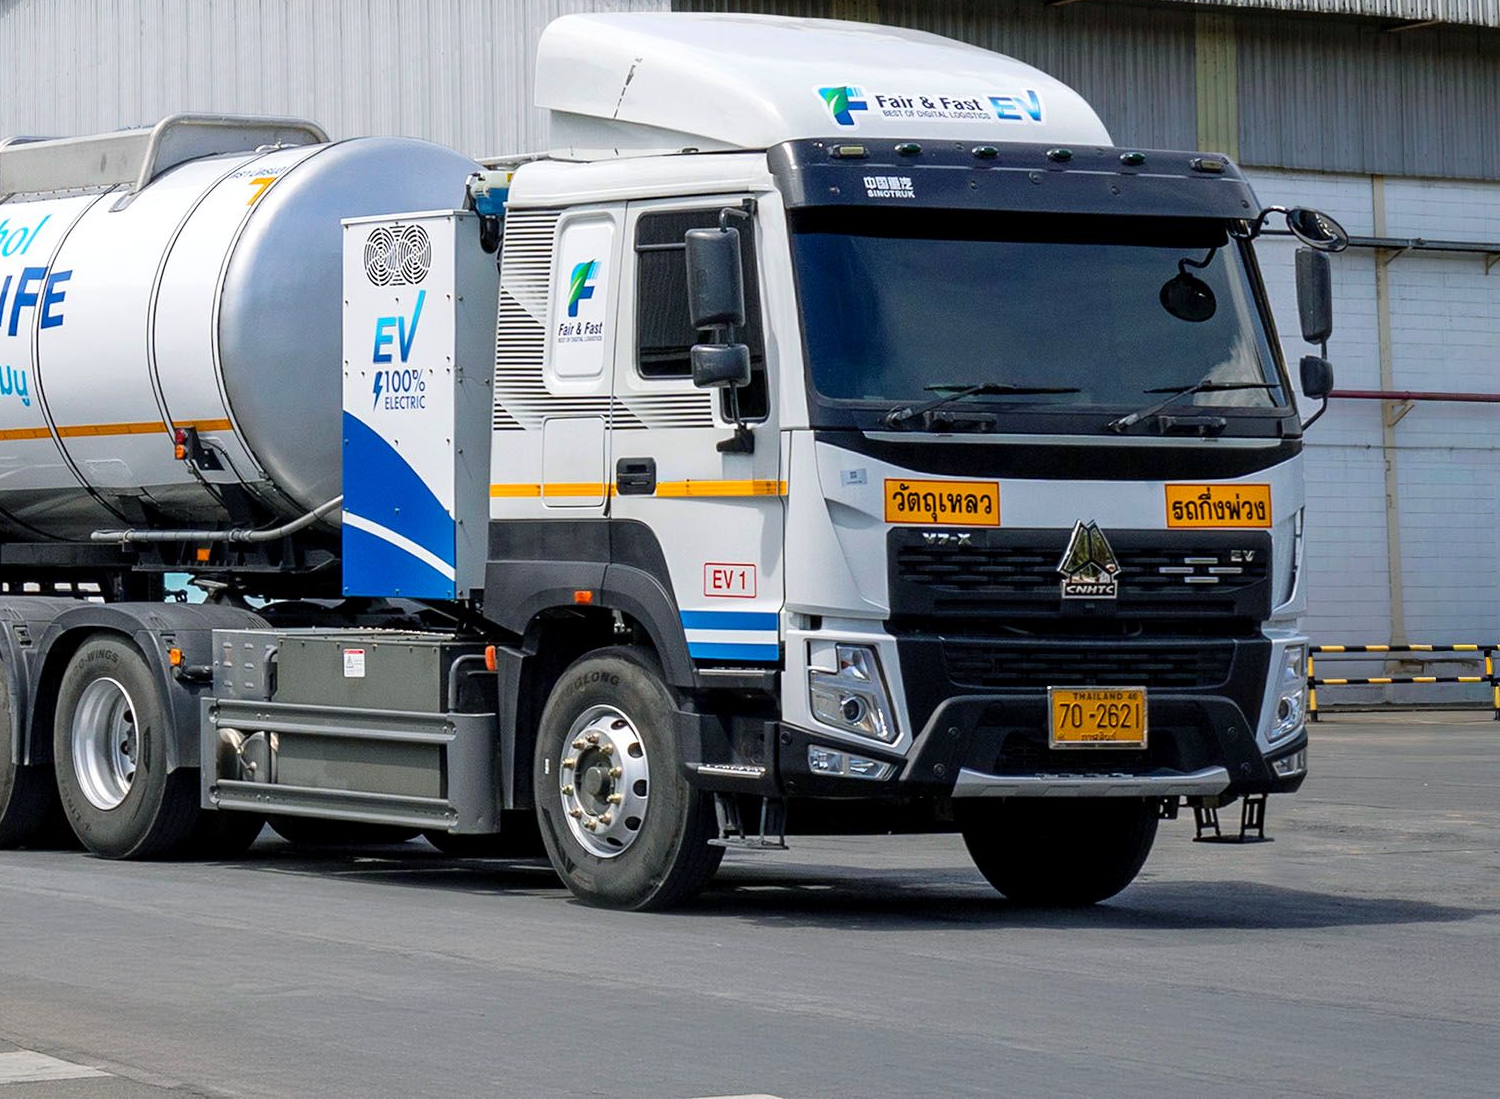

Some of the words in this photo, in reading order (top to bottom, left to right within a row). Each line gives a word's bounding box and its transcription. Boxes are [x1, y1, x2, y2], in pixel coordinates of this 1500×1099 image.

[875, 95, 914, 108] Fair
[919, 96, 936, 109] &
[939, 97, 983, 111] Fast
[988, 89, 1042, 122] EV
[867, 190, 915, 199] SINOTRUK
[373, 290, 426, 364] EV
[558, 322, 574, 336] Fair
[576, 322, 582, 335] &
[584, 321, 602, 335] Fast
[384, 369, 426, 392] 100%
[385, 395, 426, 410] ELECTRIC
[893, 483, 992, 522] วัตถุเหลว
[1172, 487, 1266, 521] รถกึ่งพ่วง
[1230, 549, 1255, 562] EV
[713, 570, 734, 589] EV
[739, 571, 746, 589] 1
[1066, 584, 1115, 594] CNHTC
